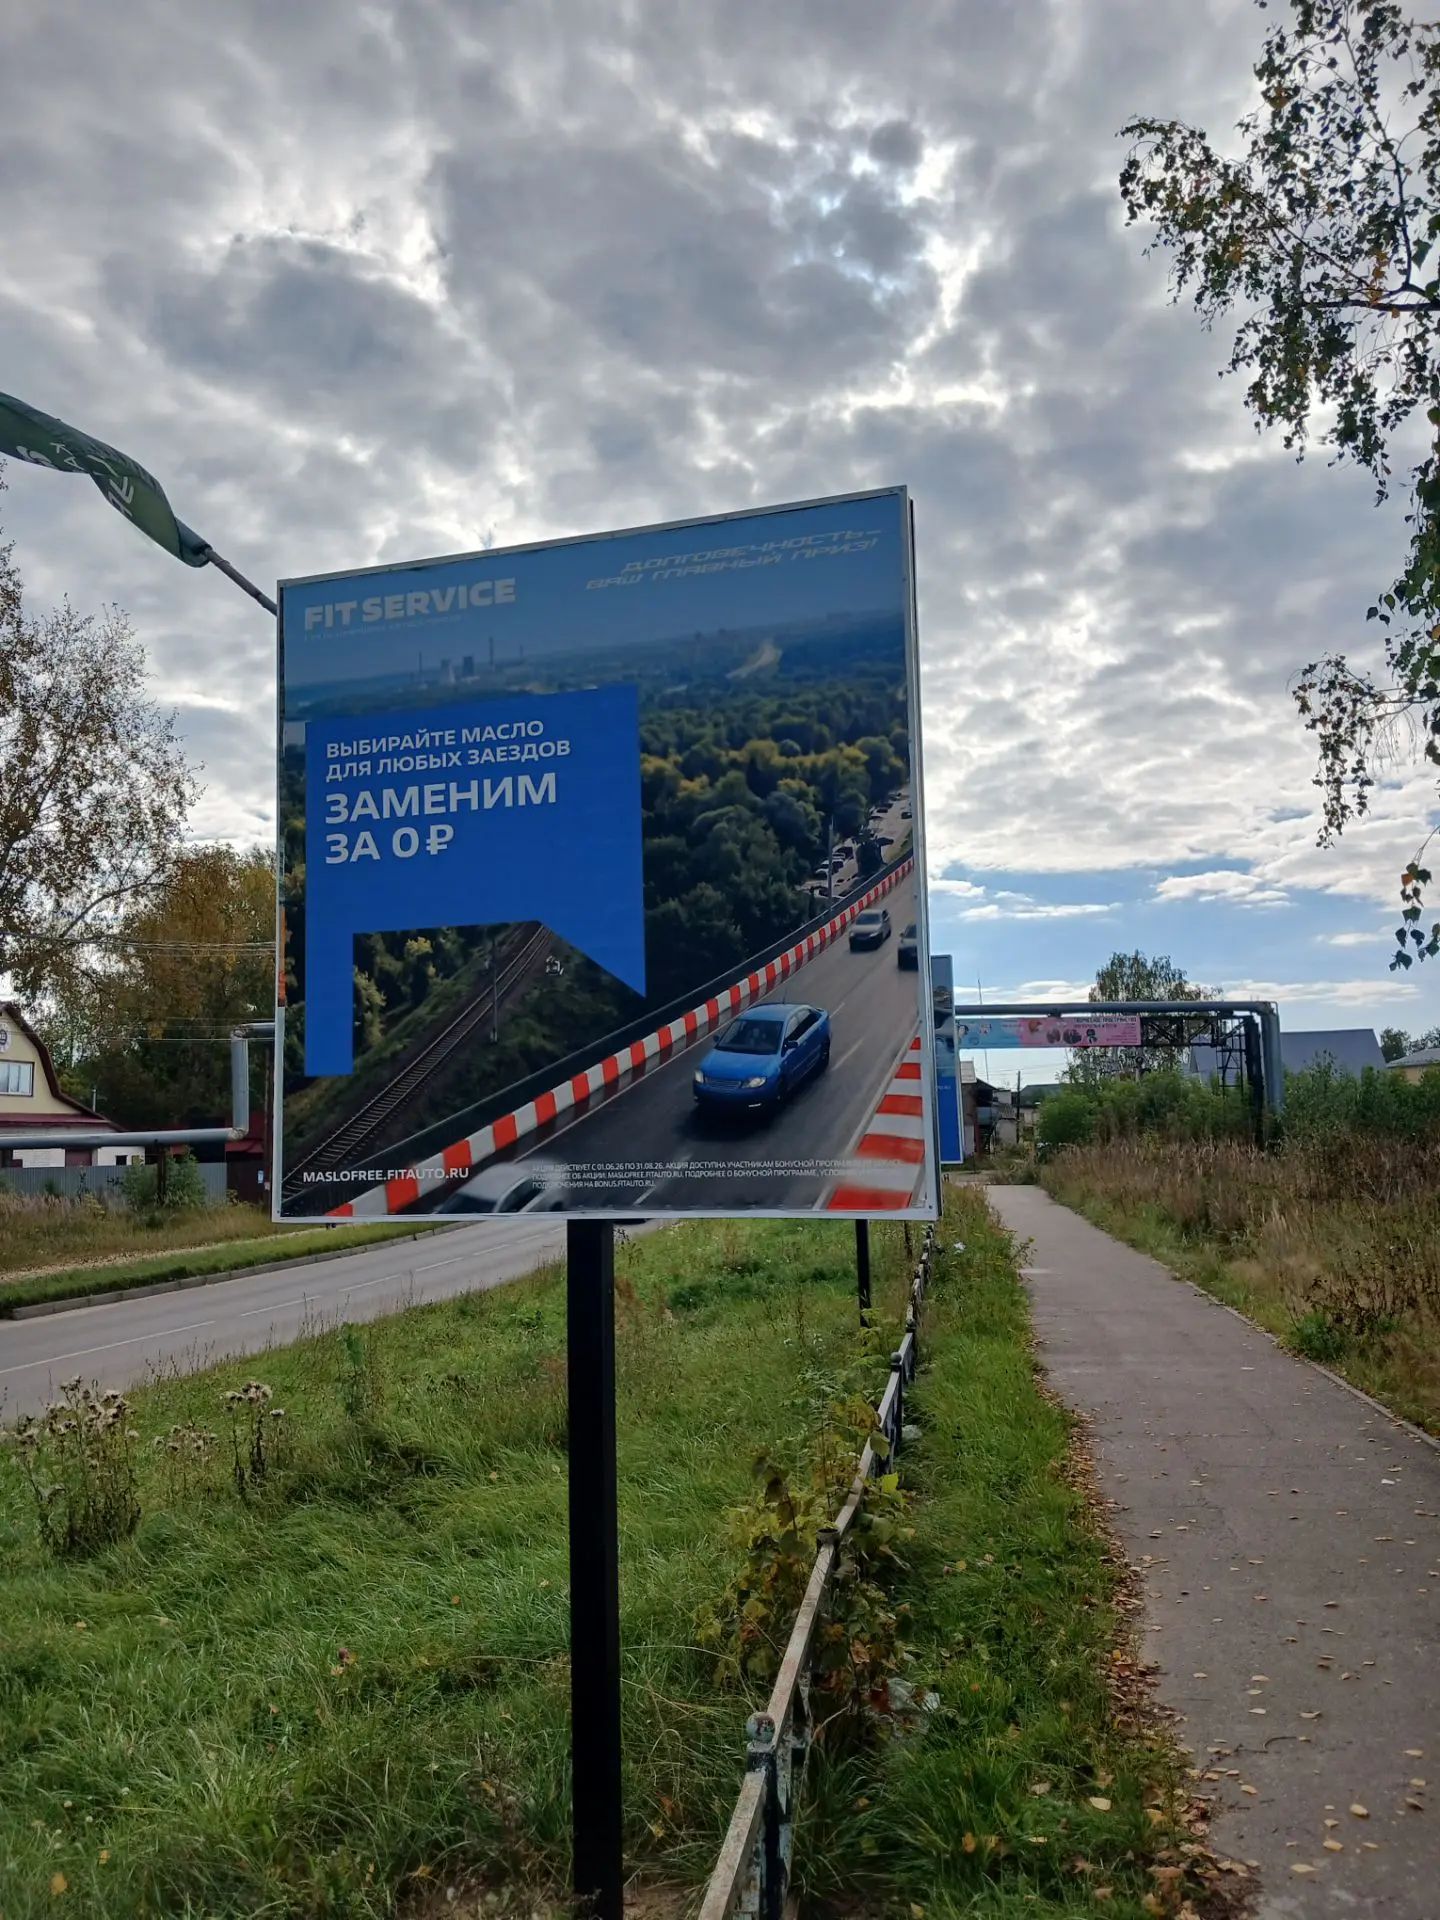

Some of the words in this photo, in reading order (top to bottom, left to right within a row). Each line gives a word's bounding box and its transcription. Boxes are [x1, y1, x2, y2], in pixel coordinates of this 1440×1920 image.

[586, 573, 644, 590] ВАШ
[652, 552, 783, 581] ГЛАВНЫЙ
[790, 537, 879, 561] ПРИЗ!
[304, 600, 357, 631] FIT
[361, 577, 517, 623] SERVICE
[326, 729, 456, 759] ВЫБИРАЙТЕ
[461, 720, 544, 744] МАСЛО
[325, 760, 372, 783] ДЛЯ
[377, 751, 462, 774] ЛЮБЫХ
[467, 740, 571, 766] ЗАЕЗДОВ
[325, 772, 557, 825] ЗАМЕНИМ
[325, 830, 381, 864] ЗА
[303, 1167, 469, 1183] MASLOFREE.FITAUTO.RU
[625, 1162, 635, 1170] ПО
[689, 1160, 727, 1170] ДОСТУПНА
[727, 1160, 774, 1168] УЧАСТНИКАМ
[774, 1158, 814, 1168] БОНУСНОЙ
[684, 1169, 726, 1178] ПОДРОБНЕЕ
[727, 1169, 733, 1177] О
[733, 1168, 773, 1177] БОНУСНОЙ
[583, 1180, 594, 1188] НА
